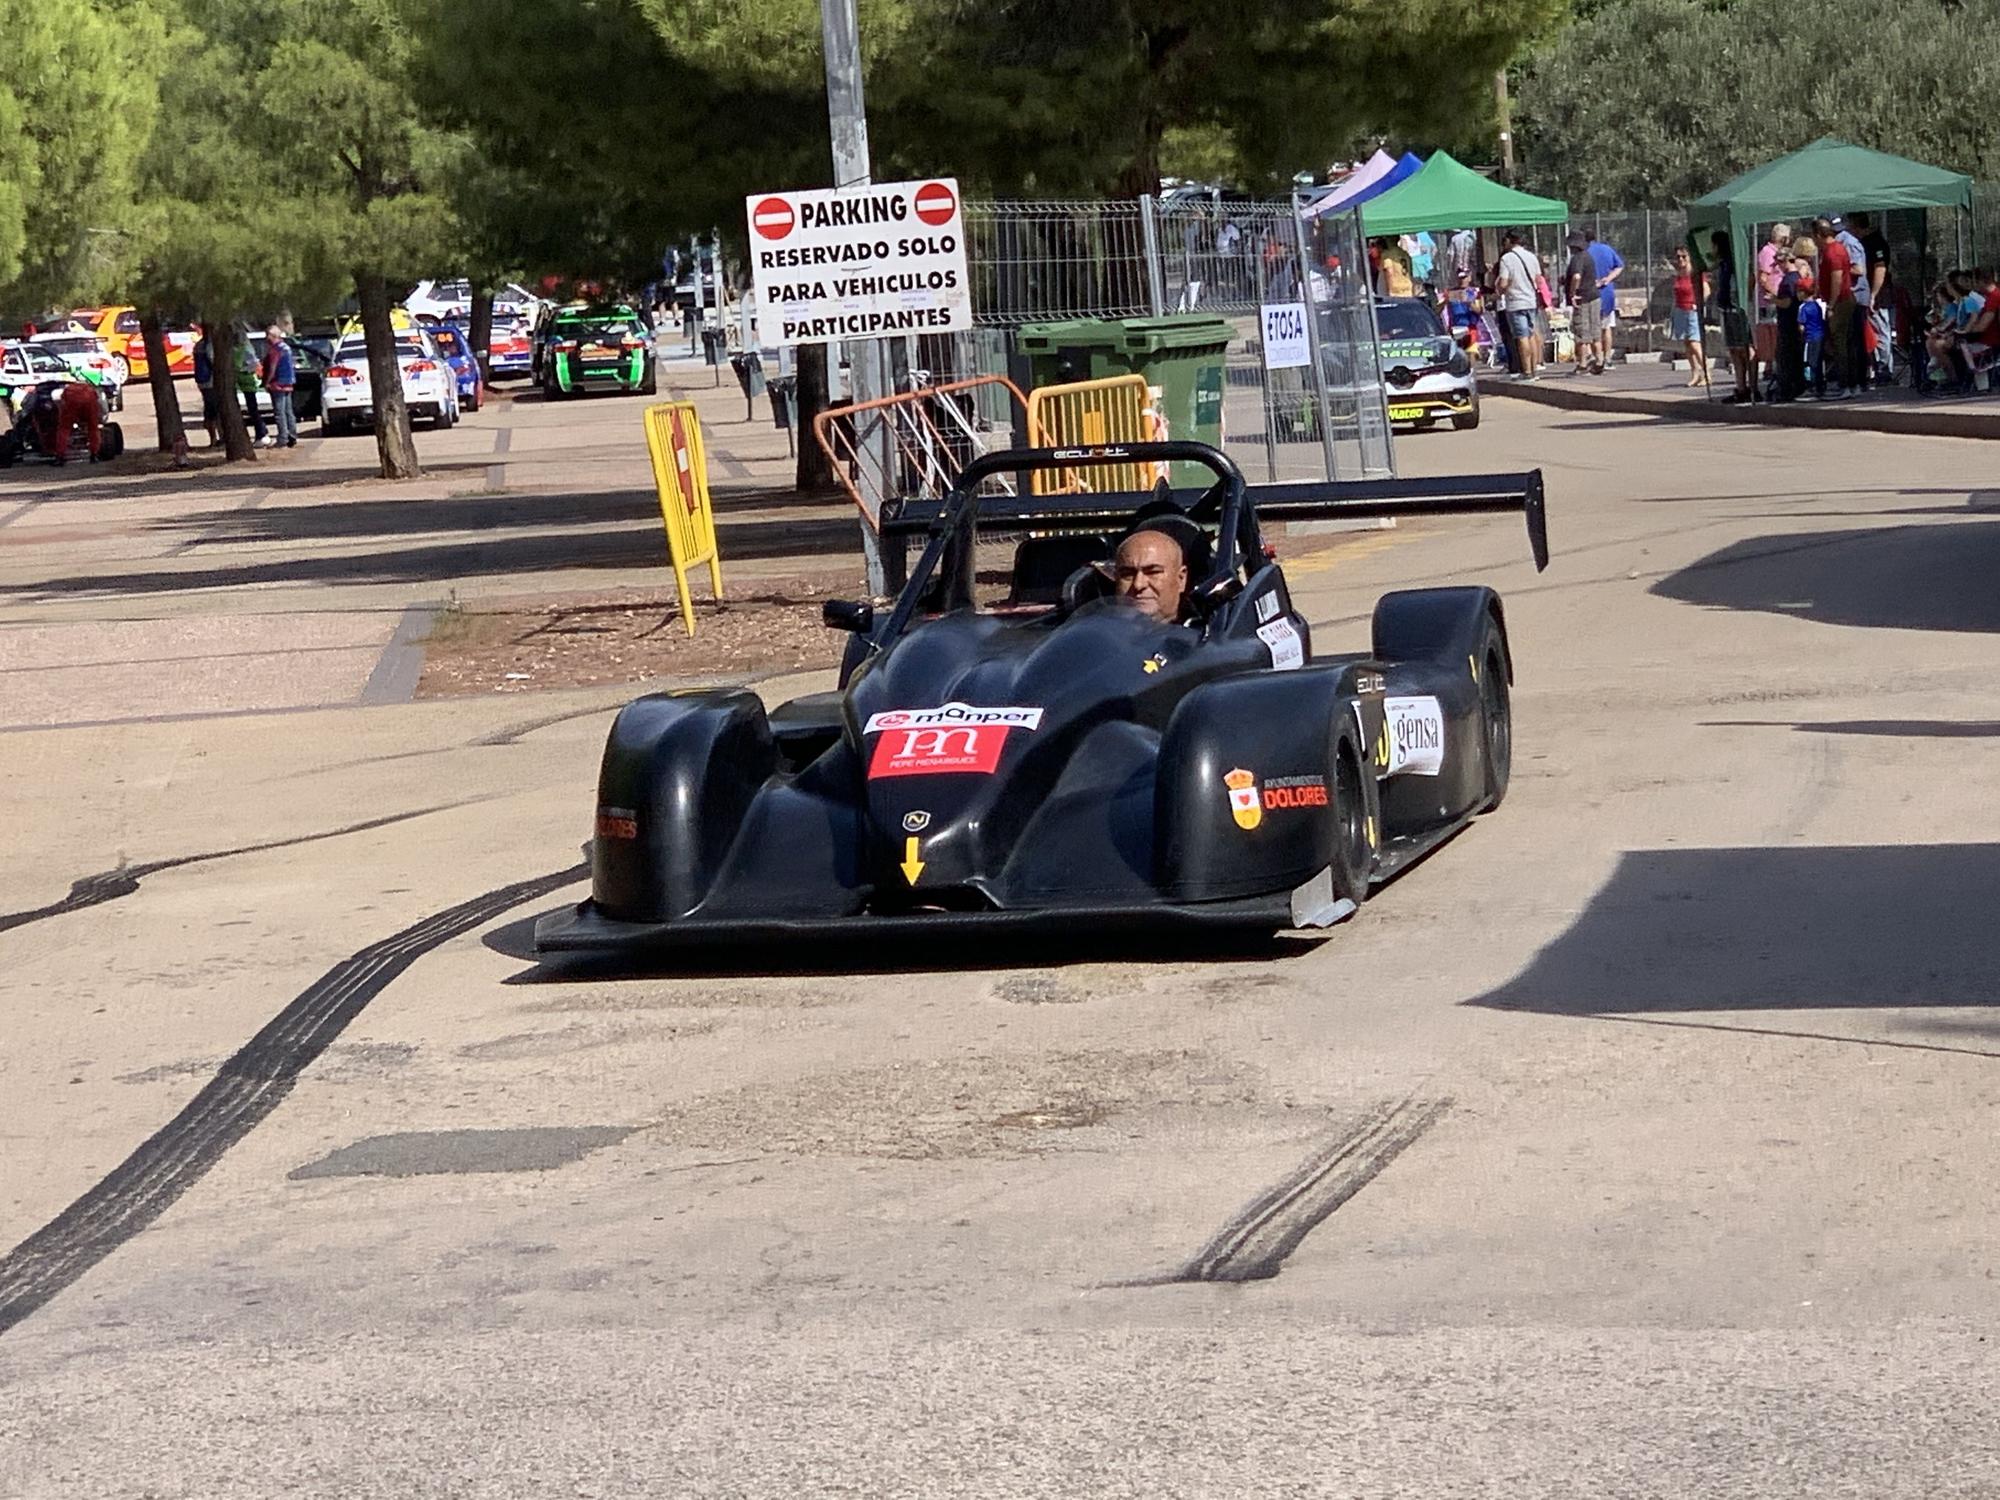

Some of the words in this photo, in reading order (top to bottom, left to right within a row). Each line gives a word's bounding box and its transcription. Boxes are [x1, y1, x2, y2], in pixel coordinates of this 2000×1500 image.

[801, 195, 907, 228] PARKING
[761, 241, 890, 268] RESERVADO
[898, 235, 956, 257] SOLO
[768, 282, 827, 303] PARA
[833, 270, 957, 297] VEHICULOS
[783, 307, 951, 339] PARTICIPANTES
[1267, 309, 1303, 341] ETOSA
[915, 708, 1035, 723] manper
[1263, 787, 1328, 809] DOLORES
